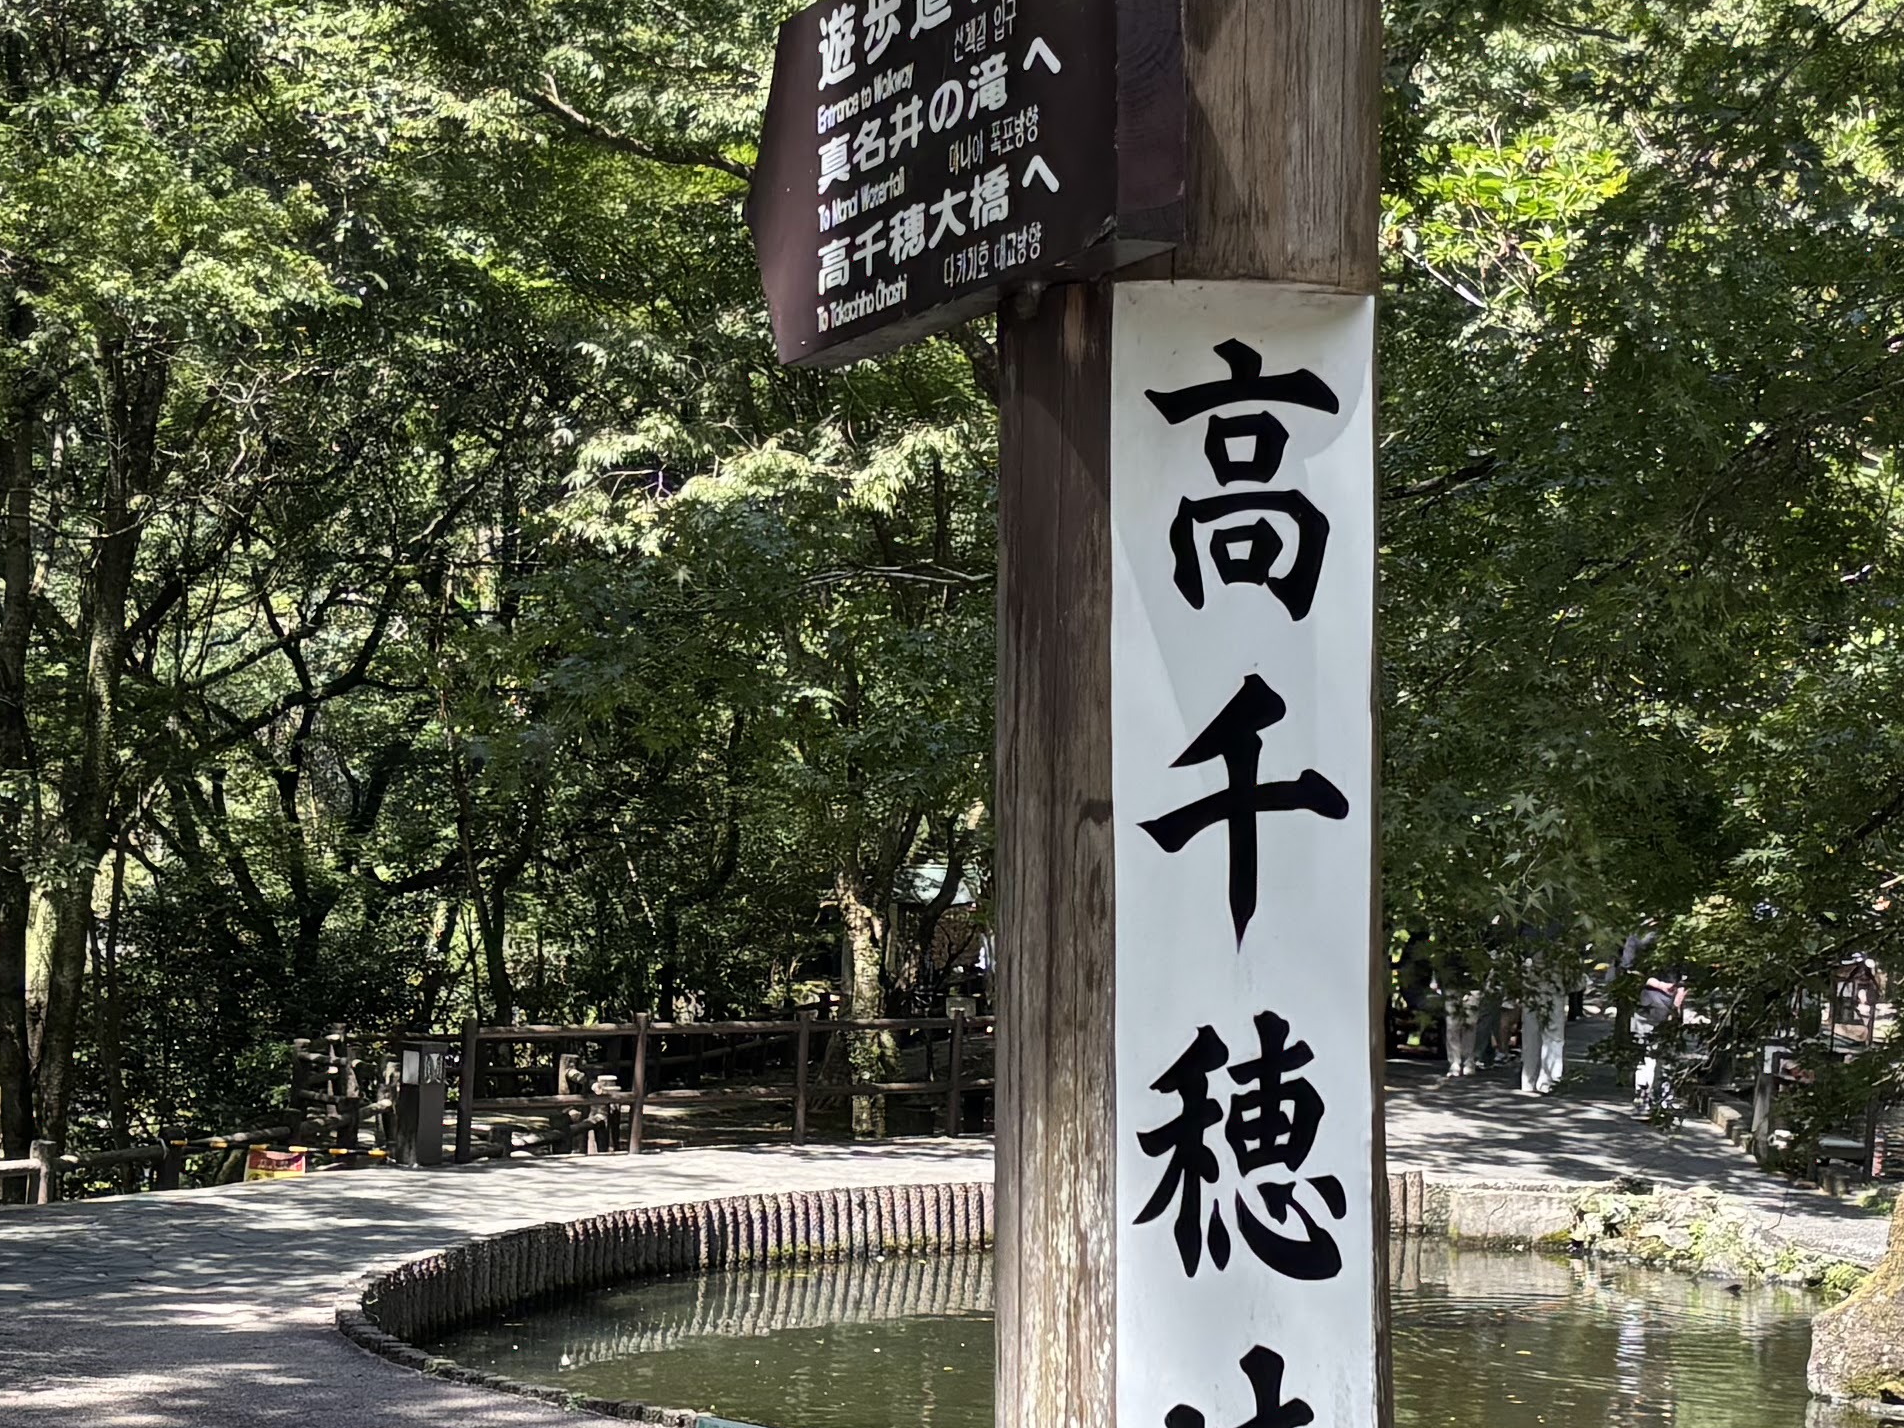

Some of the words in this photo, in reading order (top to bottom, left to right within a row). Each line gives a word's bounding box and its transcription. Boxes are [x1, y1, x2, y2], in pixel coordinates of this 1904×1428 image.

[817, 92, 859, 134] Entrance
[861, 86, 872, 110] to
[873, 62, 914, 103] Walkway
[817, 204, 831, 233] To
[860, 165, 905, 212] Waterfall
[816, 305, 829, 333] To
